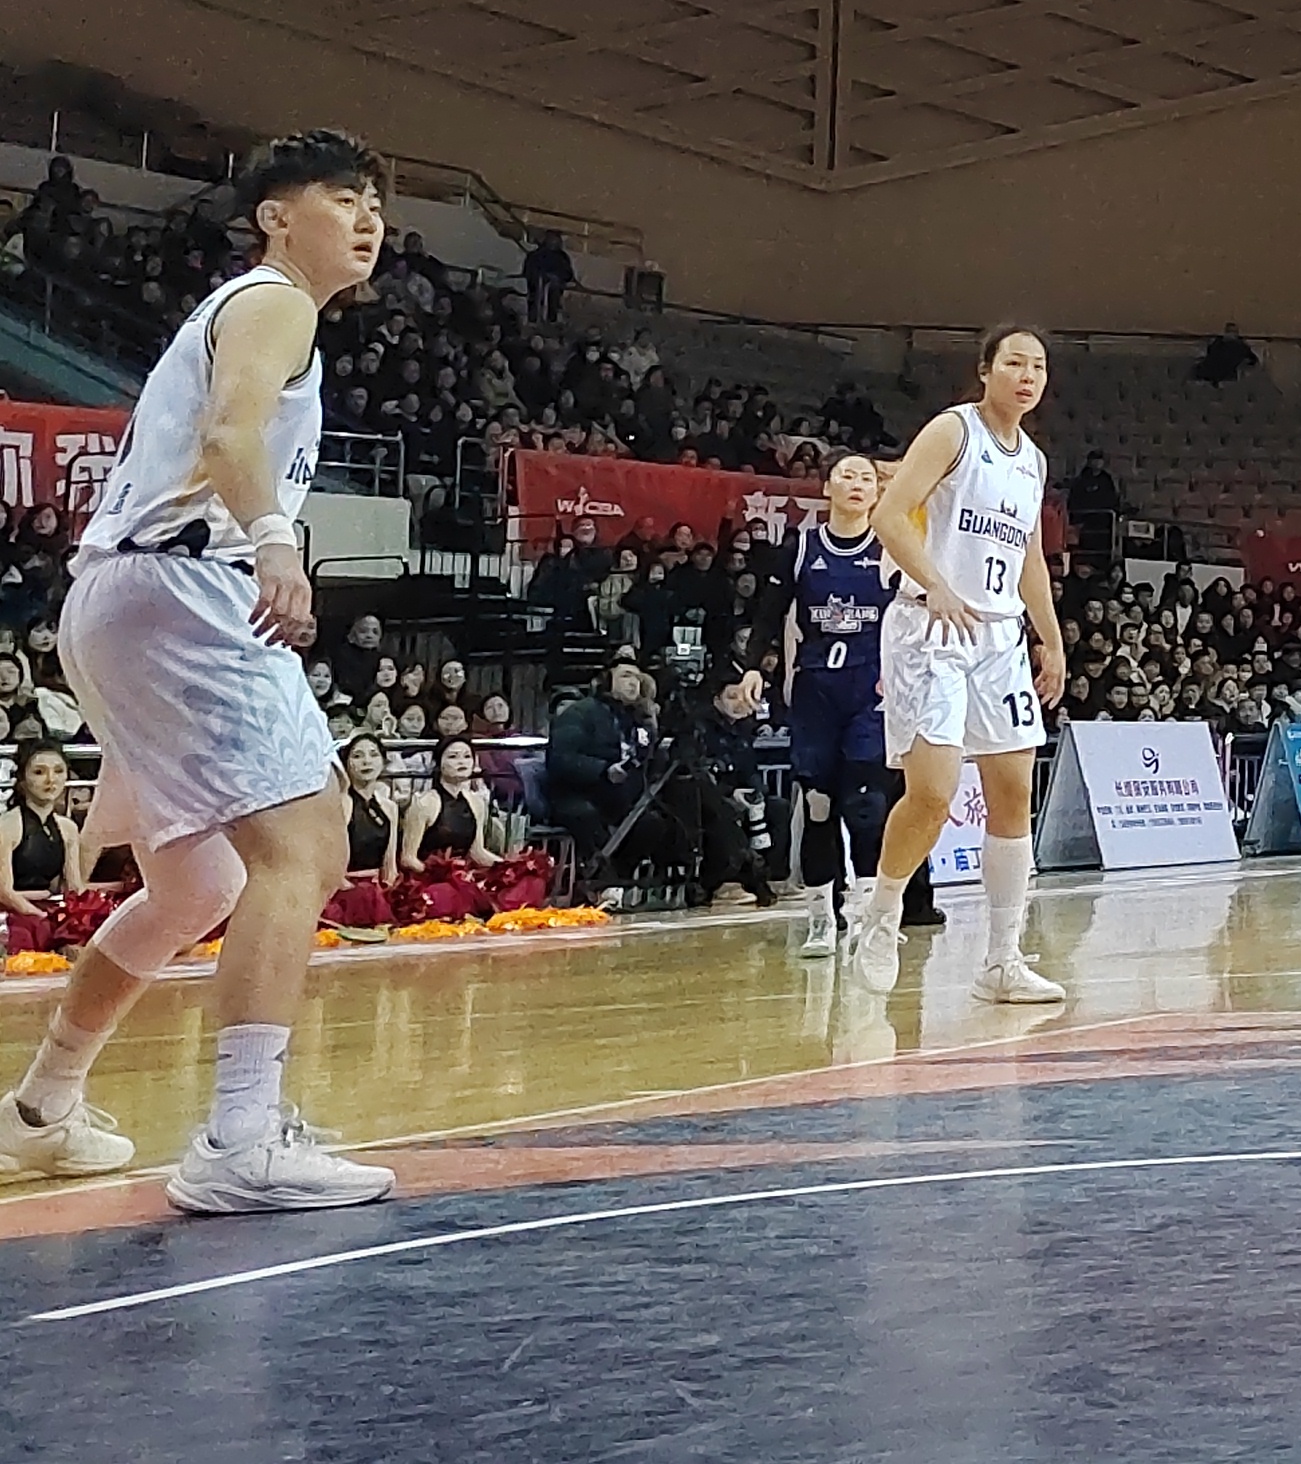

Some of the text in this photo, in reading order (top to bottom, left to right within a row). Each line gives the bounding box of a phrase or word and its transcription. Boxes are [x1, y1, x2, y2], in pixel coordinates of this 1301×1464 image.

[983, 555, 1008, 596] 13
[826, 640, 848, 669] 0
[1002, 690, 1036, 729] 13
